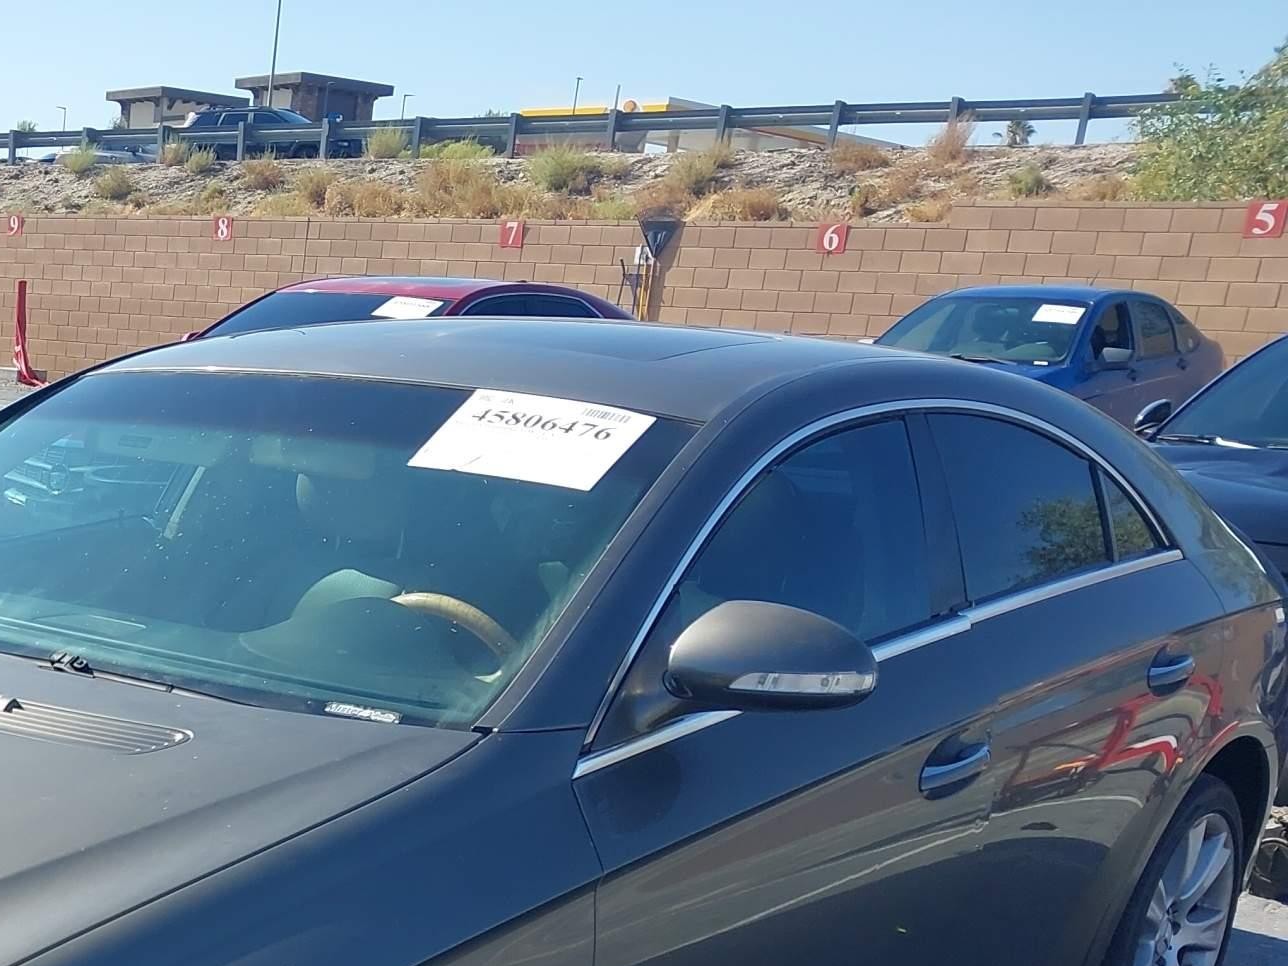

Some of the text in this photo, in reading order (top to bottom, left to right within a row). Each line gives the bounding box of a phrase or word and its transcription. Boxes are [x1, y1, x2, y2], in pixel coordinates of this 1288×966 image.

[10, 215, 19, 235] 9
[218, 217, 228, 239] 8
[1251, 203, 1280, 235] 5
[506, 221, 519, 245] 7
[823, 224, 841, 251] 6
[471, 408, 617, 441] 45806476
